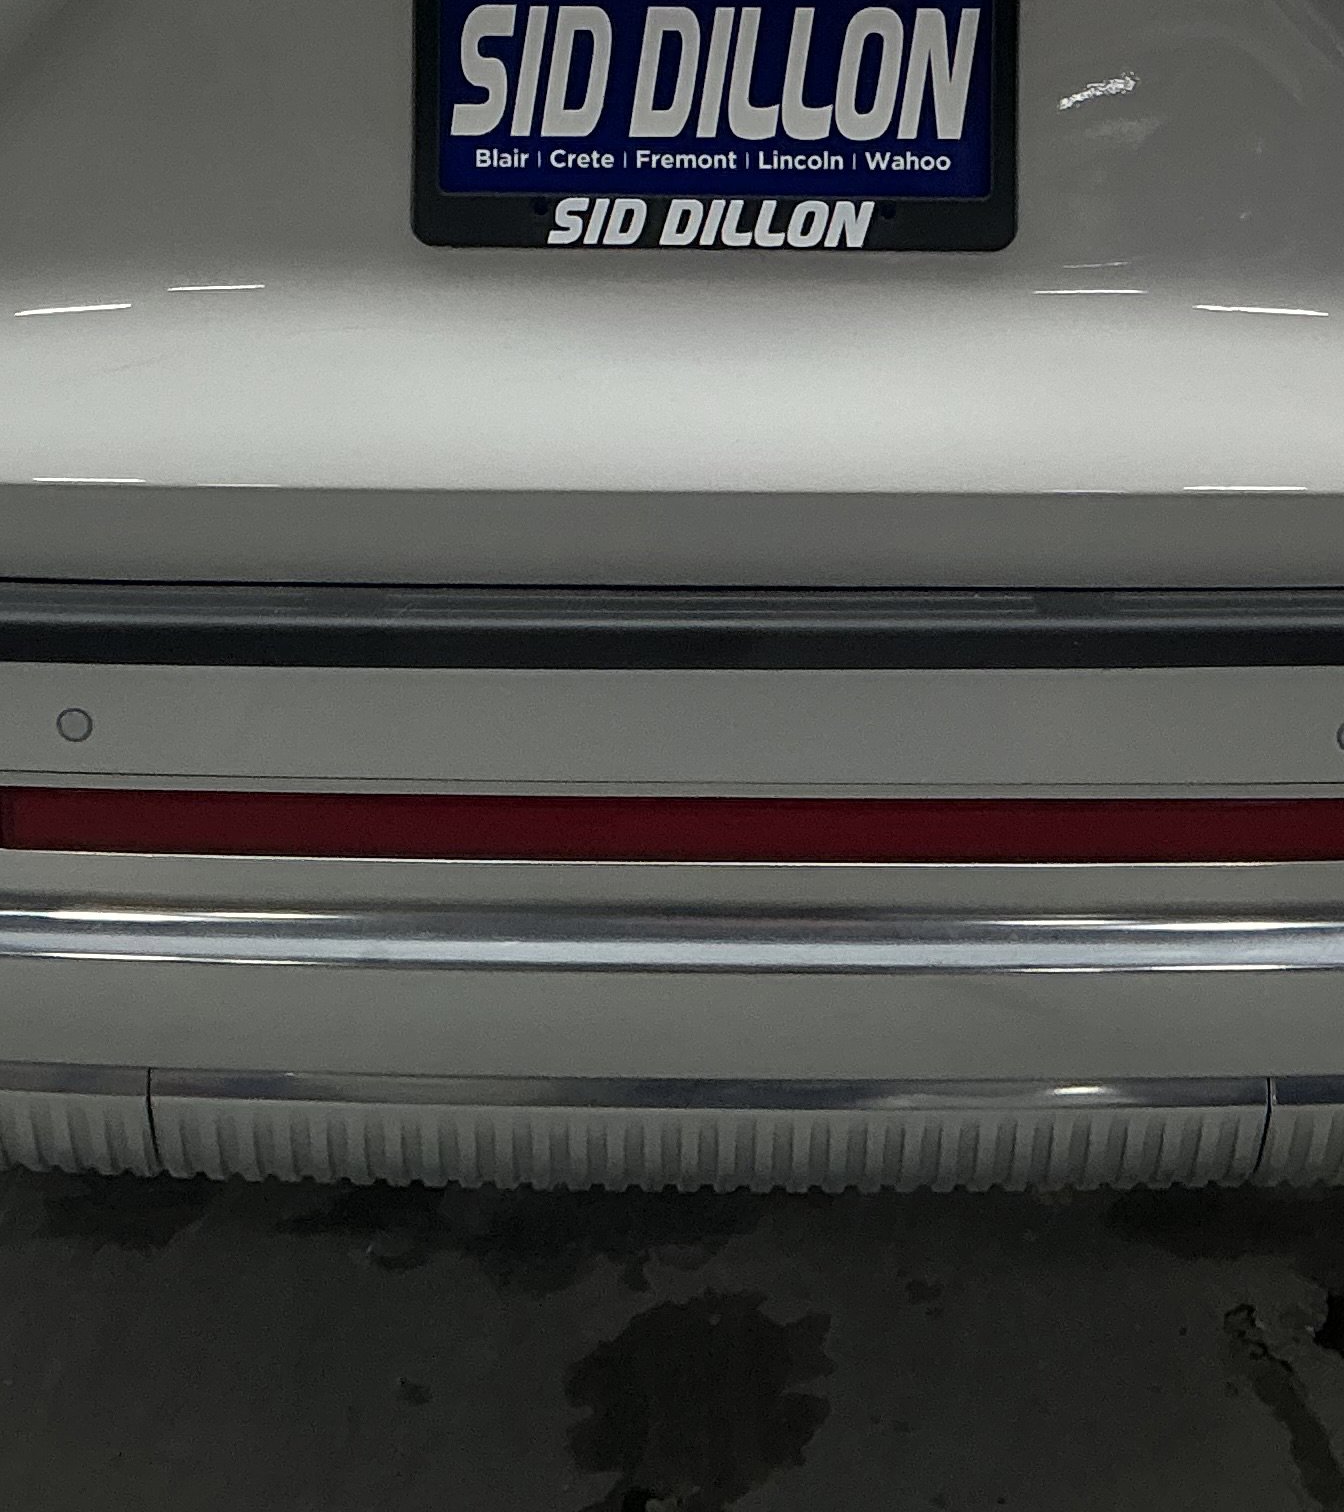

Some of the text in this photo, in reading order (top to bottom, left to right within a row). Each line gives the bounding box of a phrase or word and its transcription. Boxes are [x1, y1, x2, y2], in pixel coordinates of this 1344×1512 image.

[450, 3, 981, 140] SID DILLON
[475, 149, 952, 172] Blair Crete Fremont Lincoln Wahoo
[548, 197, 875, 248] SID DILLON
